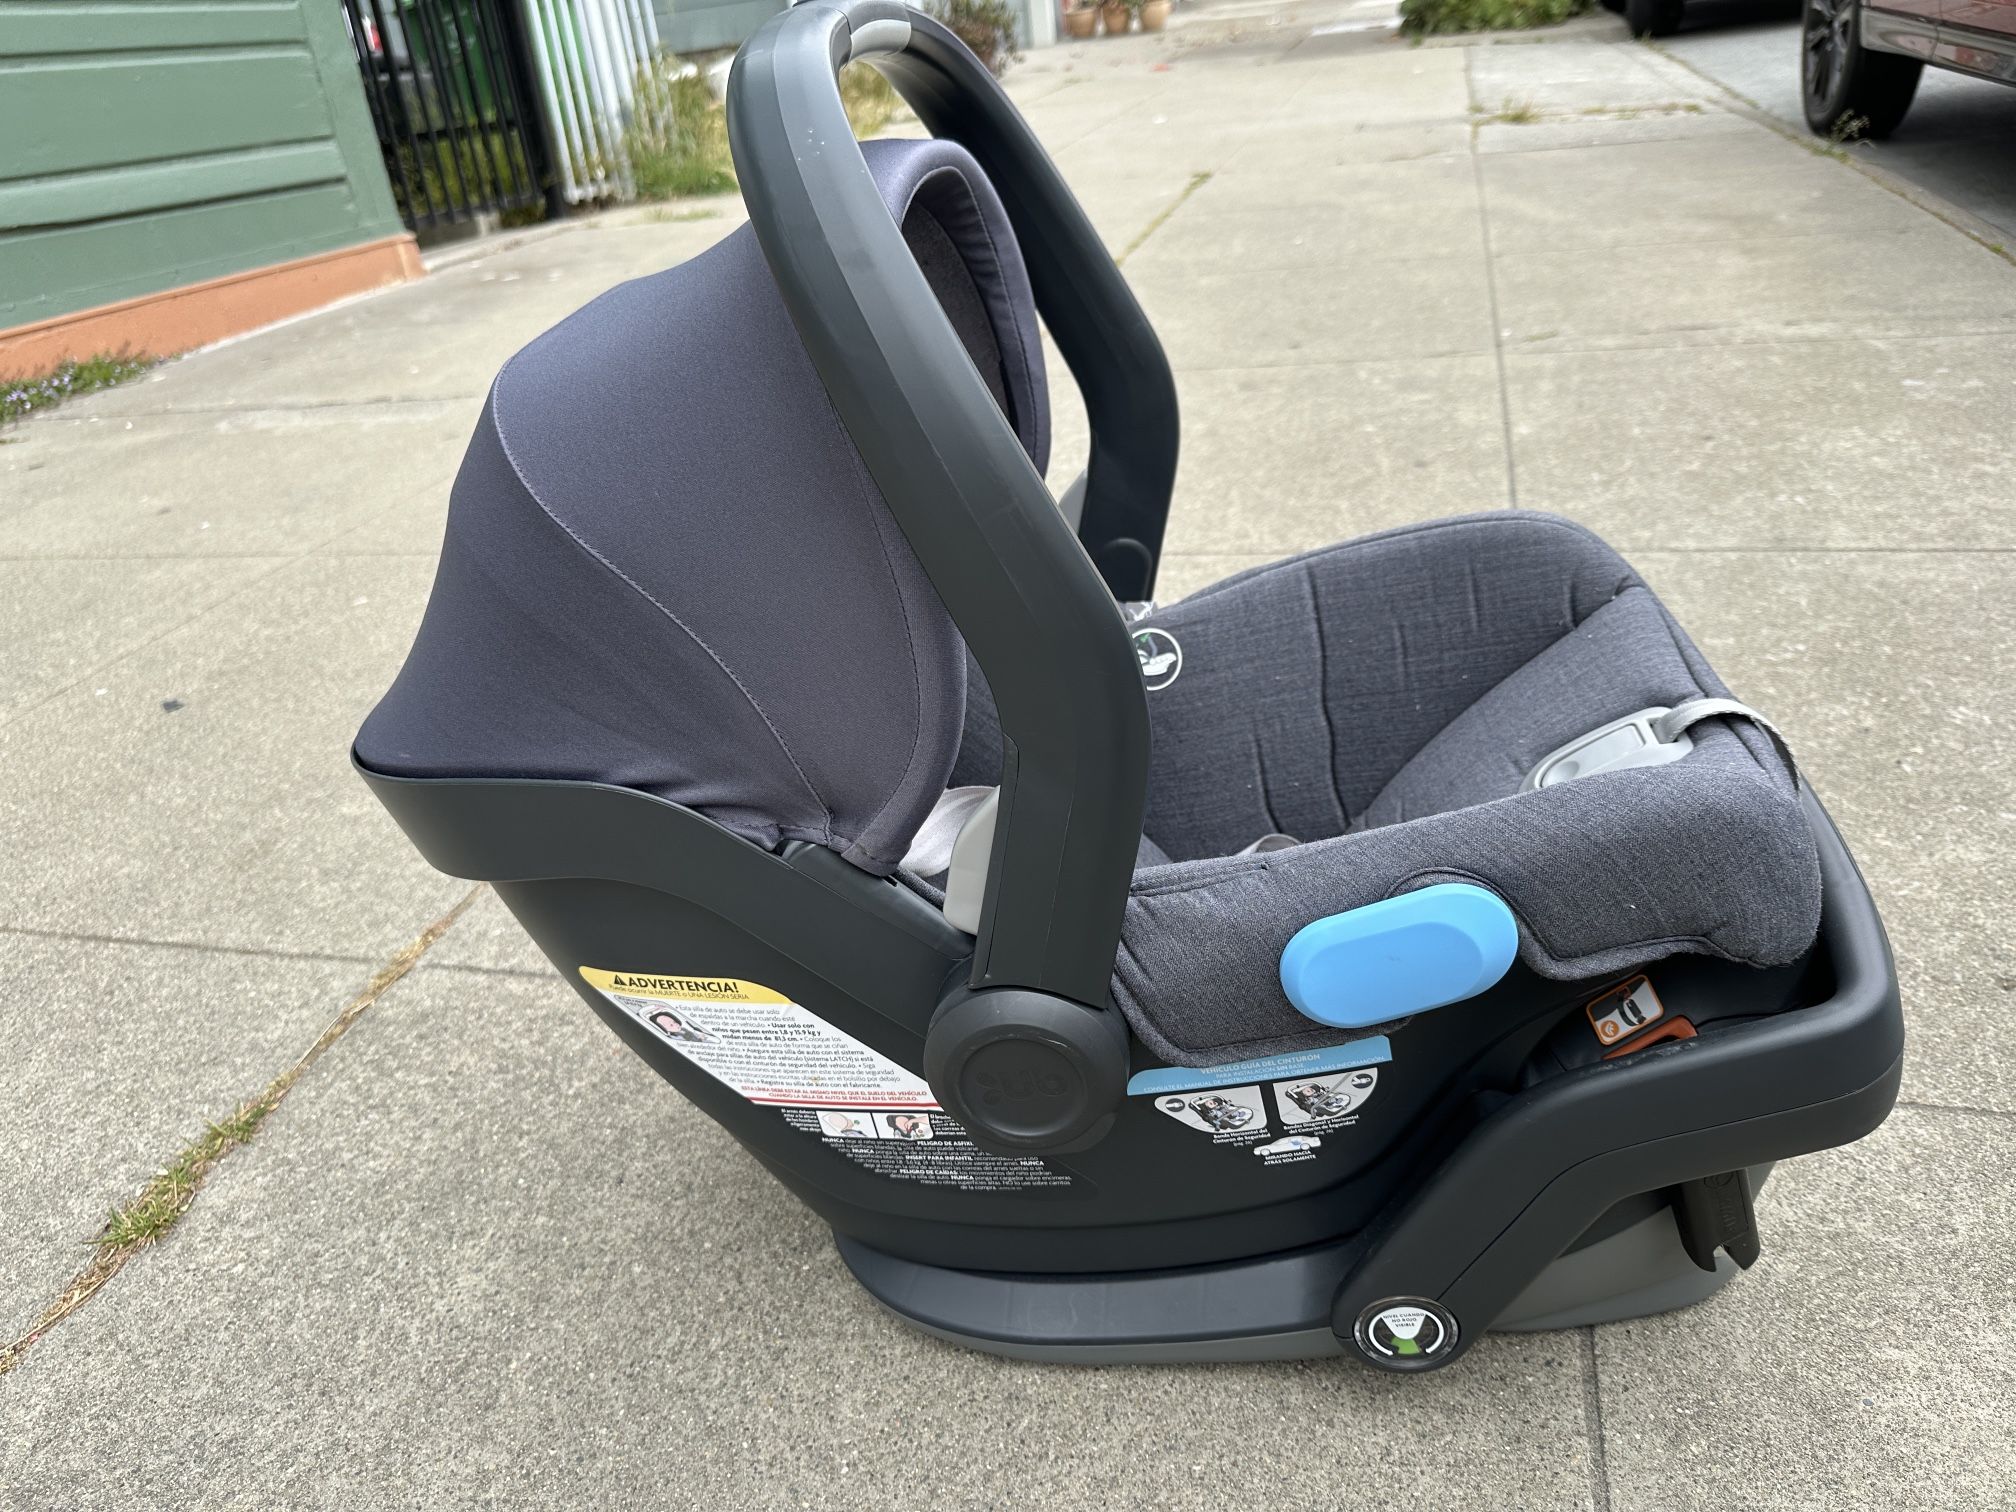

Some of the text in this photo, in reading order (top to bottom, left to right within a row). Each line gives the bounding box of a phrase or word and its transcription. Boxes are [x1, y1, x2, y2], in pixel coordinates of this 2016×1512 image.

[628, 977, 739, 993] ADVERTENCIA!
[1241, 1061, 1260, 1071] GUÍA
[1262, 1060, 1276, 1068] DEL
[1332, 1114, 1360, 1122] Horizontal
[1329, 1120, 1356, 1128] Seguridad
[1244, 1132, 1271, 1140] Seguridad
[1265, 1152, 1293, 1160] MIRANDO
[1282, 1154, 1316, 1163] SOLAMENTE
